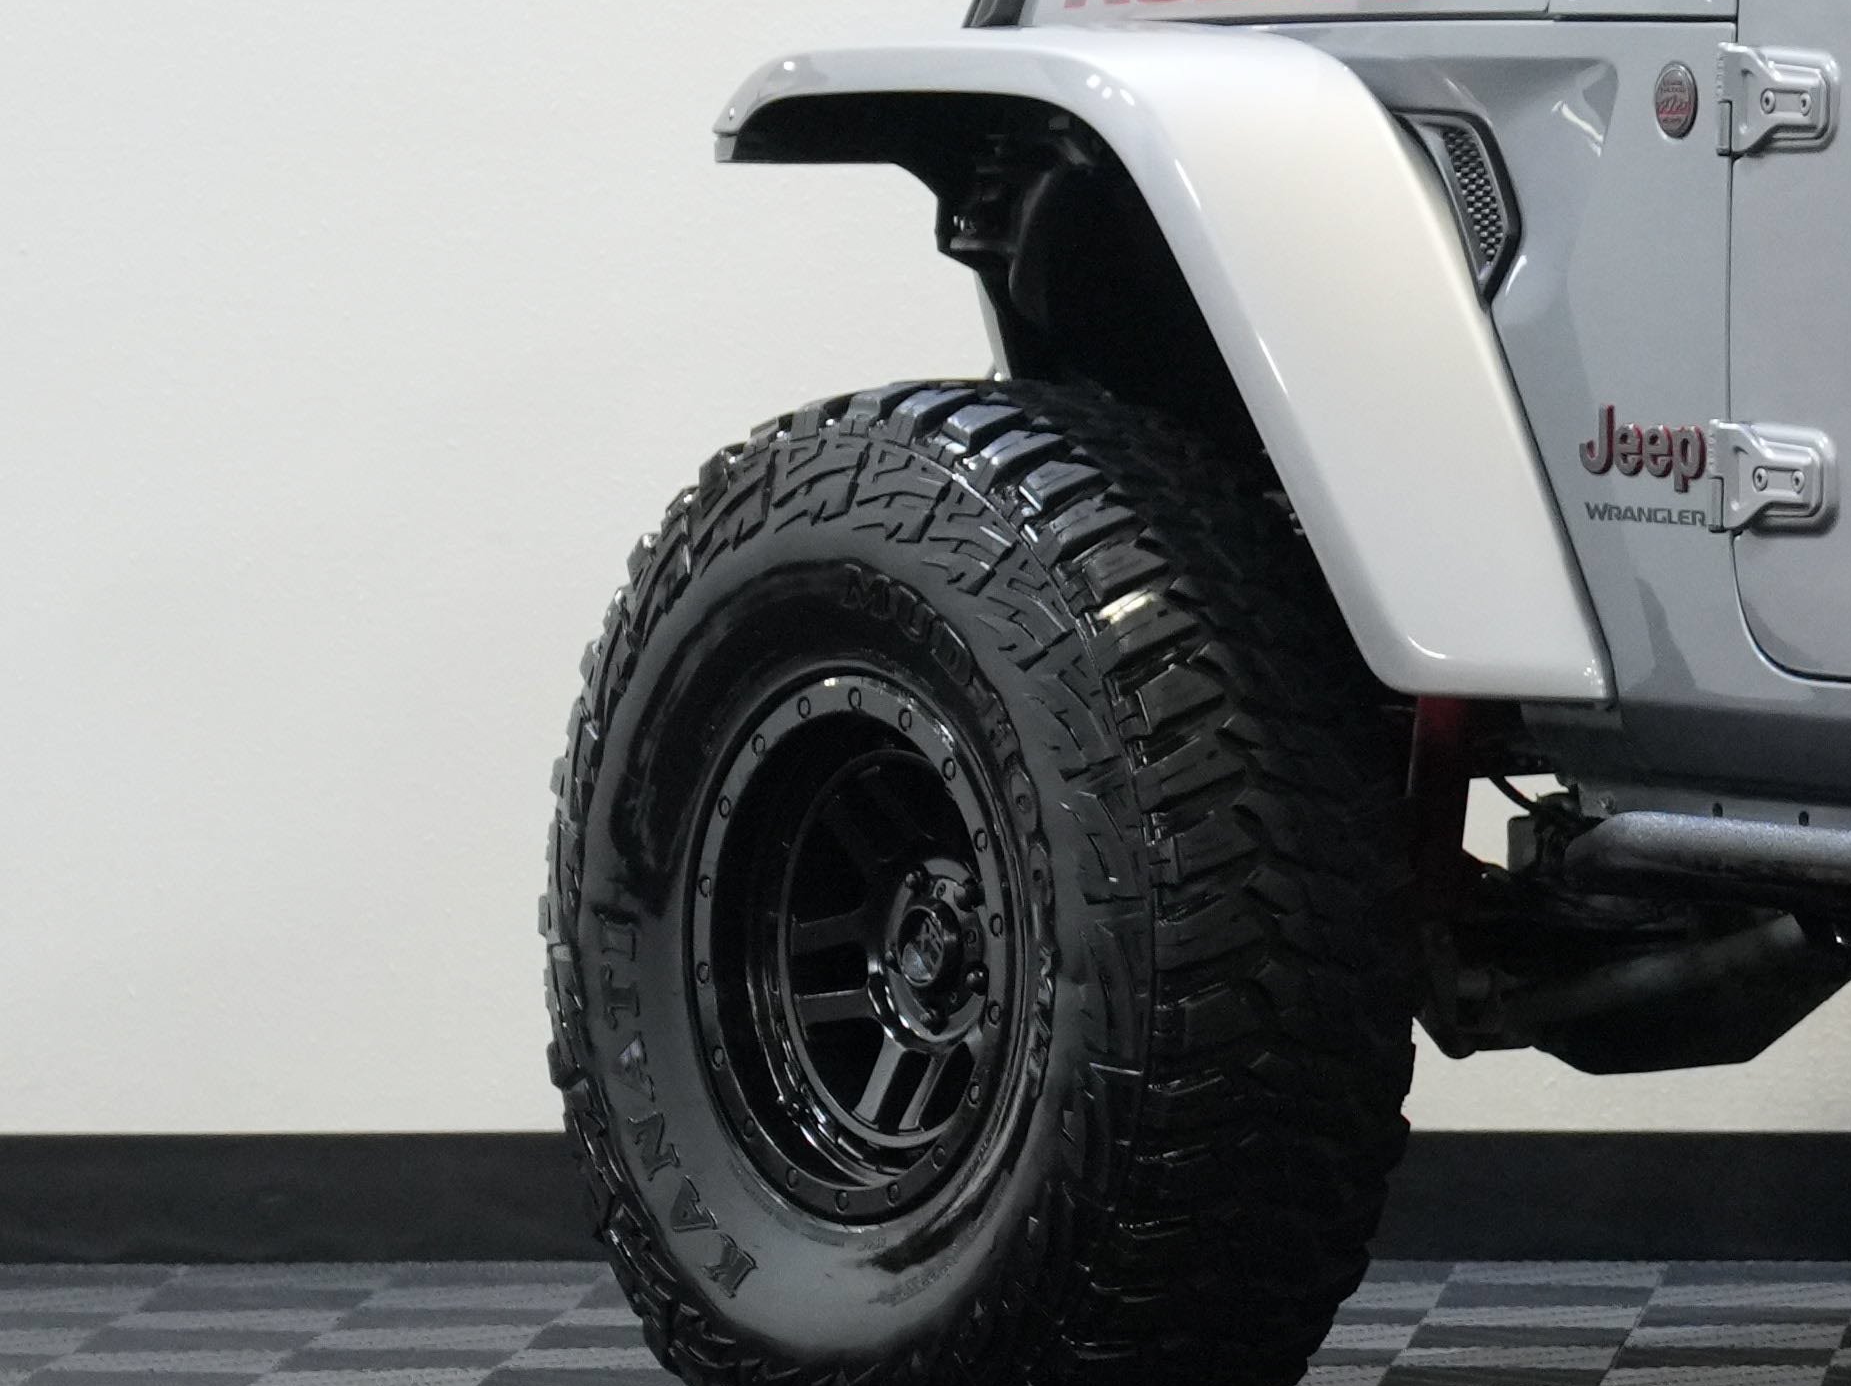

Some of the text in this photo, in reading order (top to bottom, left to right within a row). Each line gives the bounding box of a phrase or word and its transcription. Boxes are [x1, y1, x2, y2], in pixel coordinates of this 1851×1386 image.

[1578, 403, 1706, 492] Jeep
[1583, 502, 1706, 527] WRANGLER
[840, 570, 973, 687] MUD
[592, 906, 760, 1299] KANATI
